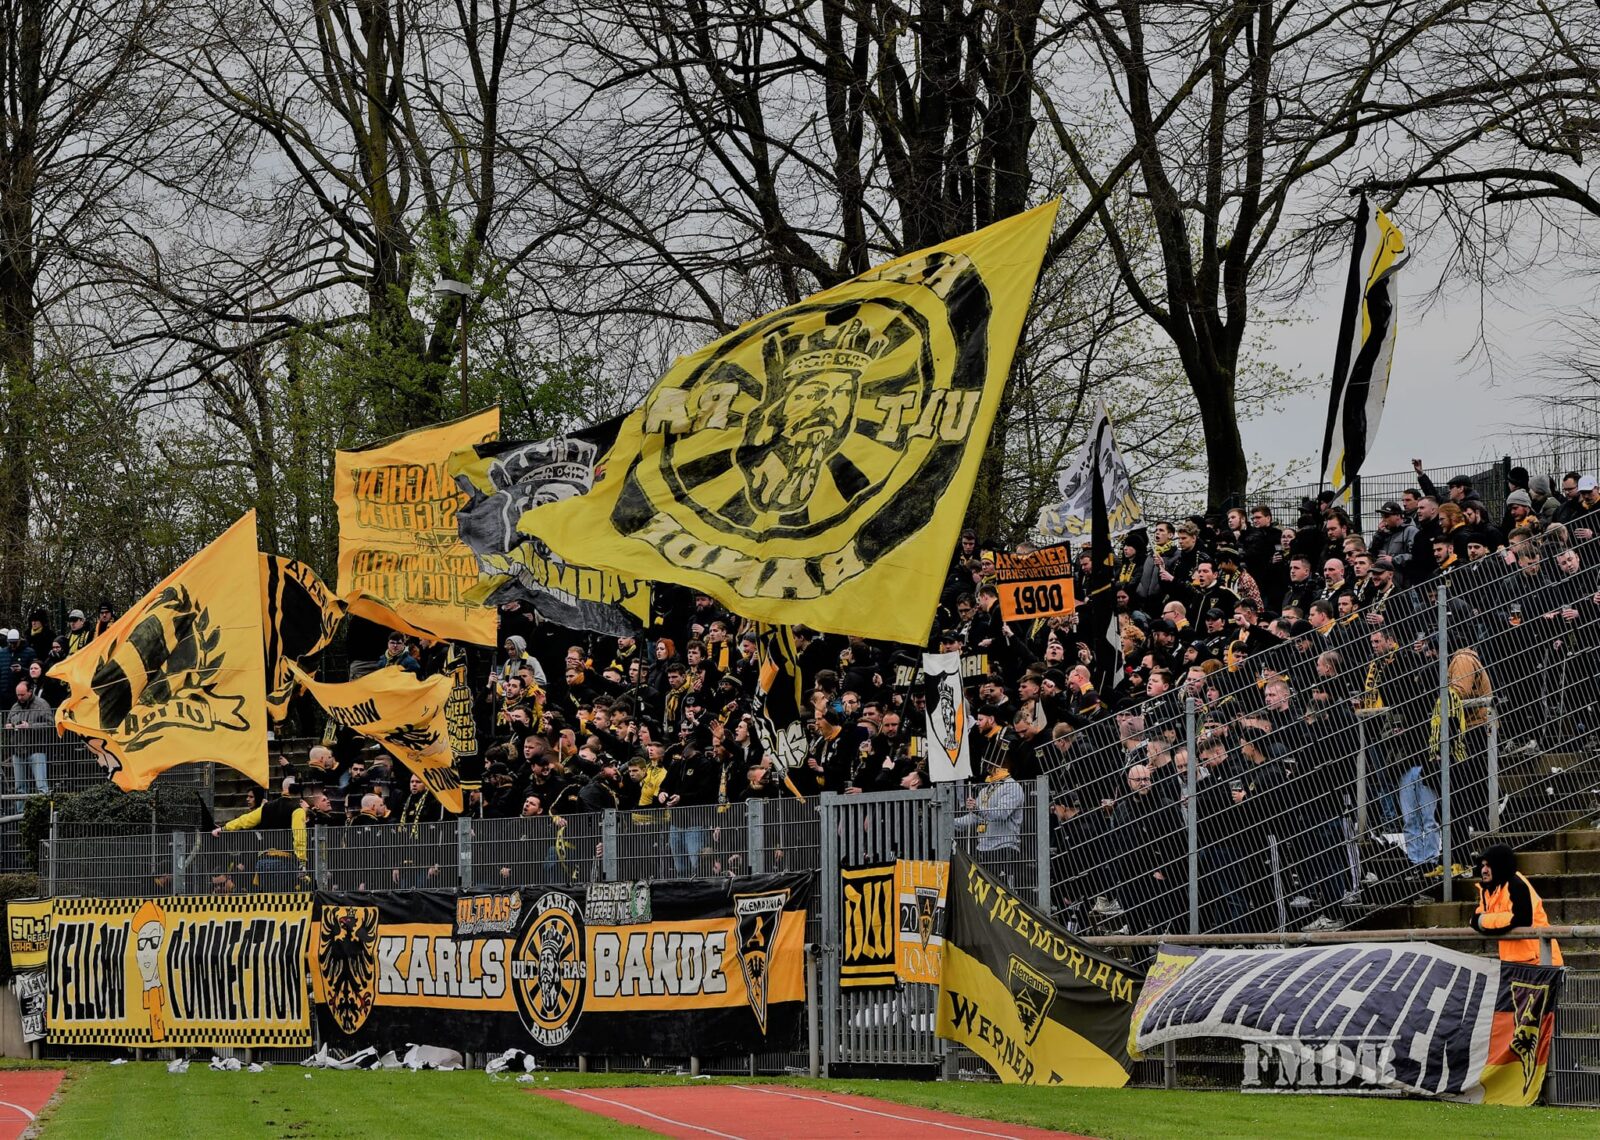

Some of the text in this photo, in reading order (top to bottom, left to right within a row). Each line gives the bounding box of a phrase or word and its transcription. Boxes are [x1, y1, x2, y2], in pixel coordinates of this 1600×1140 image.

[1013, 583, 1063, 614] 1900
[457, 894, 511, 923] ULTRAS
[537, 894, 576, 916] KARLS
[967, 863, 991, 906] IN
[989, 886, 1136, 1004] MEMORIAM
[50, 918, 308, 1020] YELLOW CONNECTION
[376, 930, 728, 999] KARLS BANDE
[511, 960, 587, 980] ULT RAS
[1011, 961, 1050, 995] Alemannia
[531, 1021, 571, 1044] BANDE
[946, 990, 1035, 1085] WERNER
[1220, 946, 1488, 1095] AACHEN
